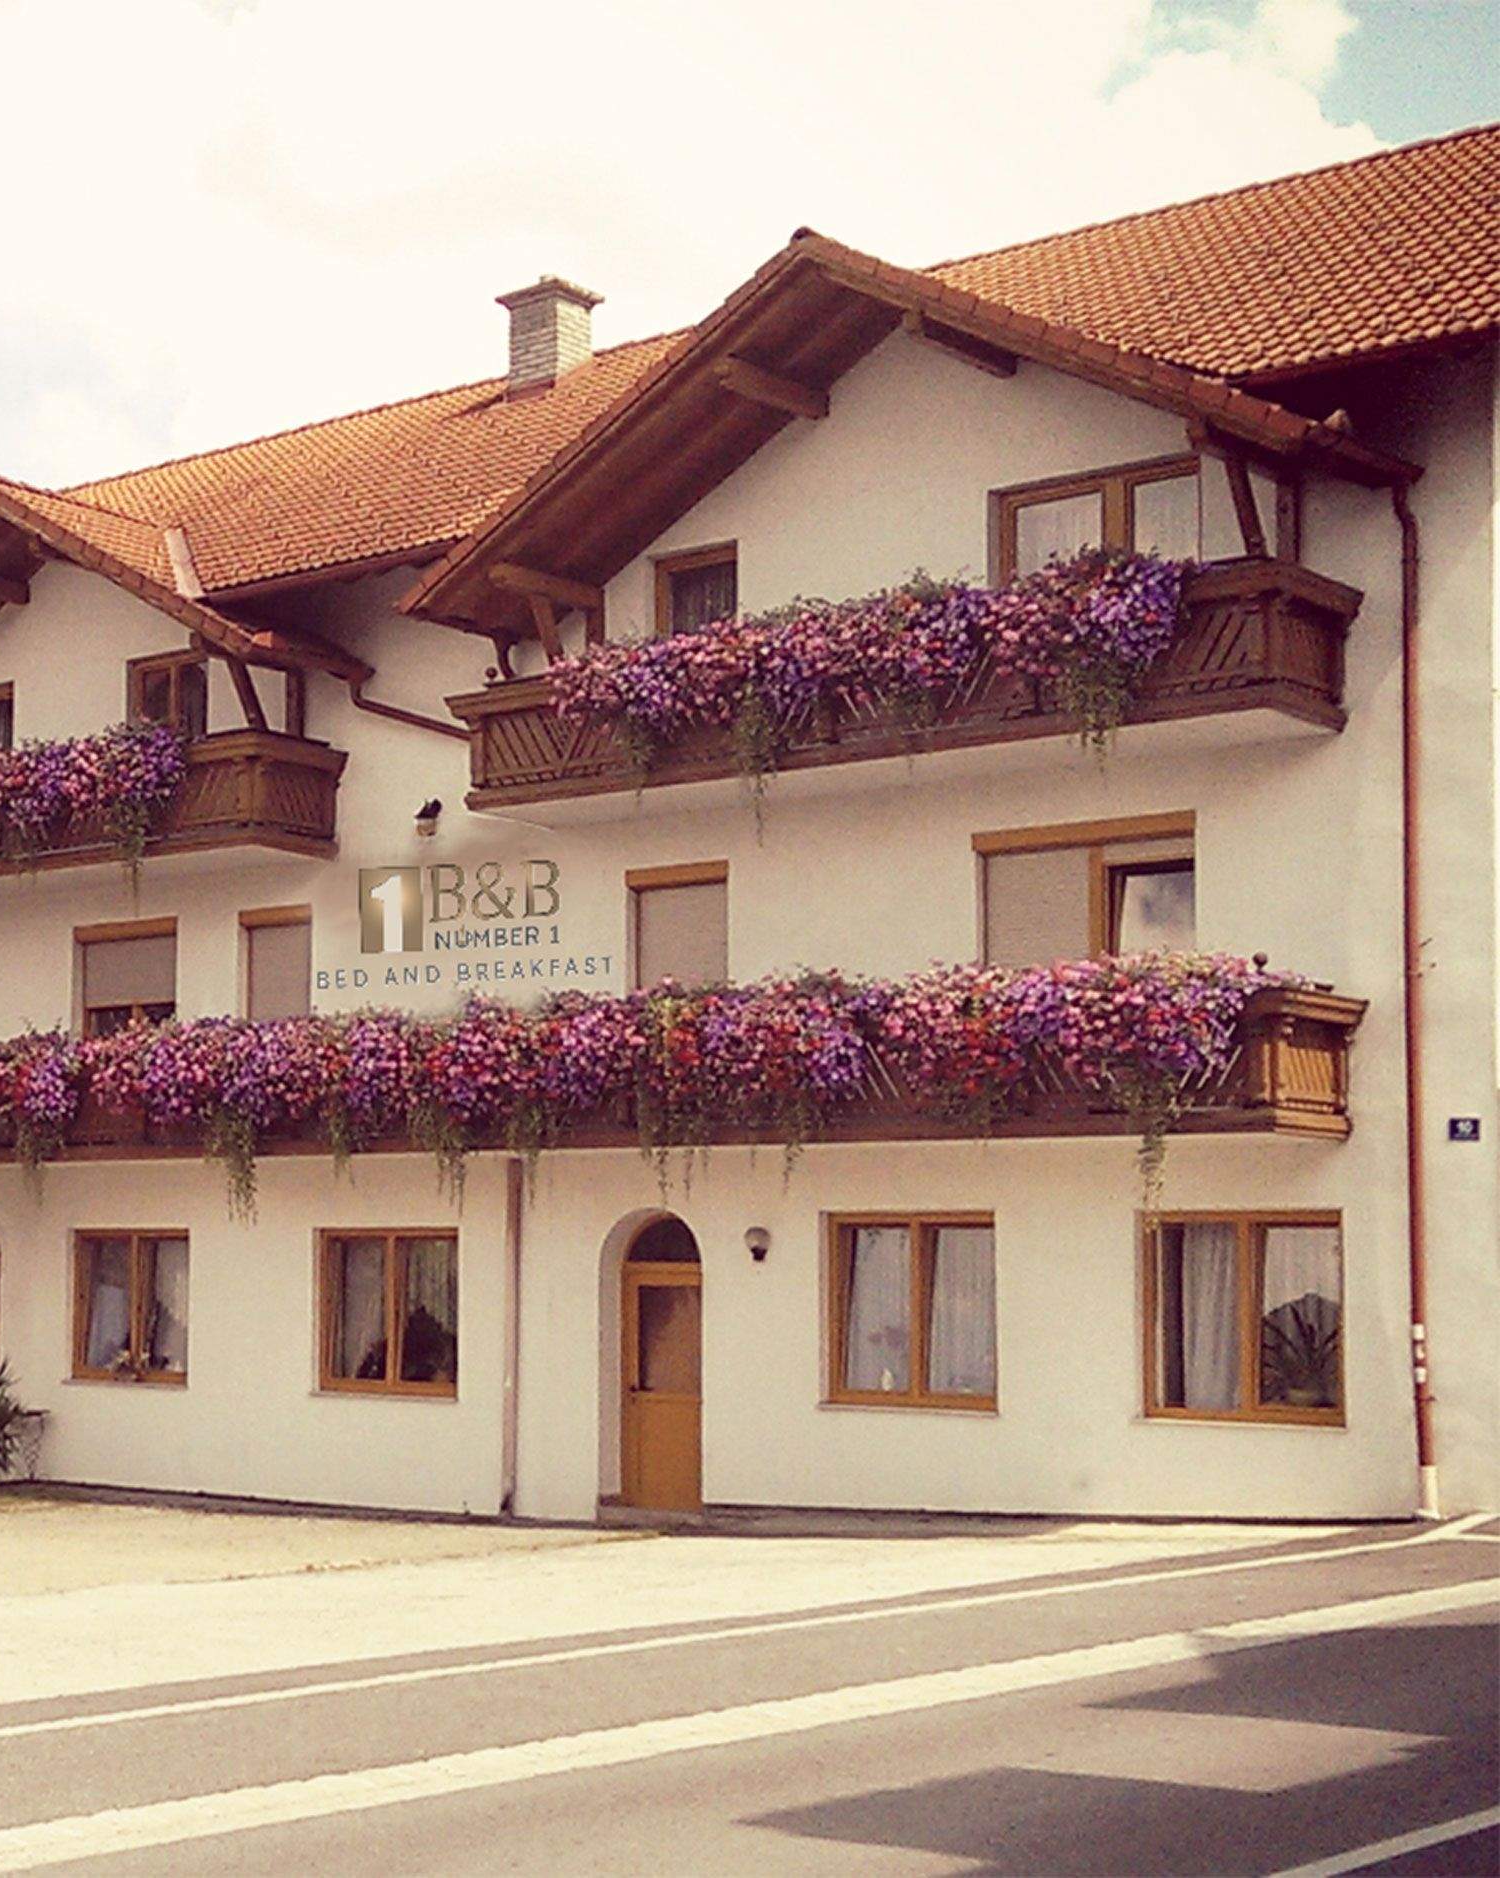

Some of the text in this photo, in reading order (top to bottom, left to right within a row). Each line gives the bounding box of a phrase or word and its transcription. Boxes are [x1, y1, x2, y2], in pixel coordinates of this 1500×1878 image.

[370, 873, 404, 954] 1
[428, 860, 561, 923] B&B
[434, 925, 560, 950] NUMBER 1
[316, 957, 613, 990] BED AND BREAKFAST
